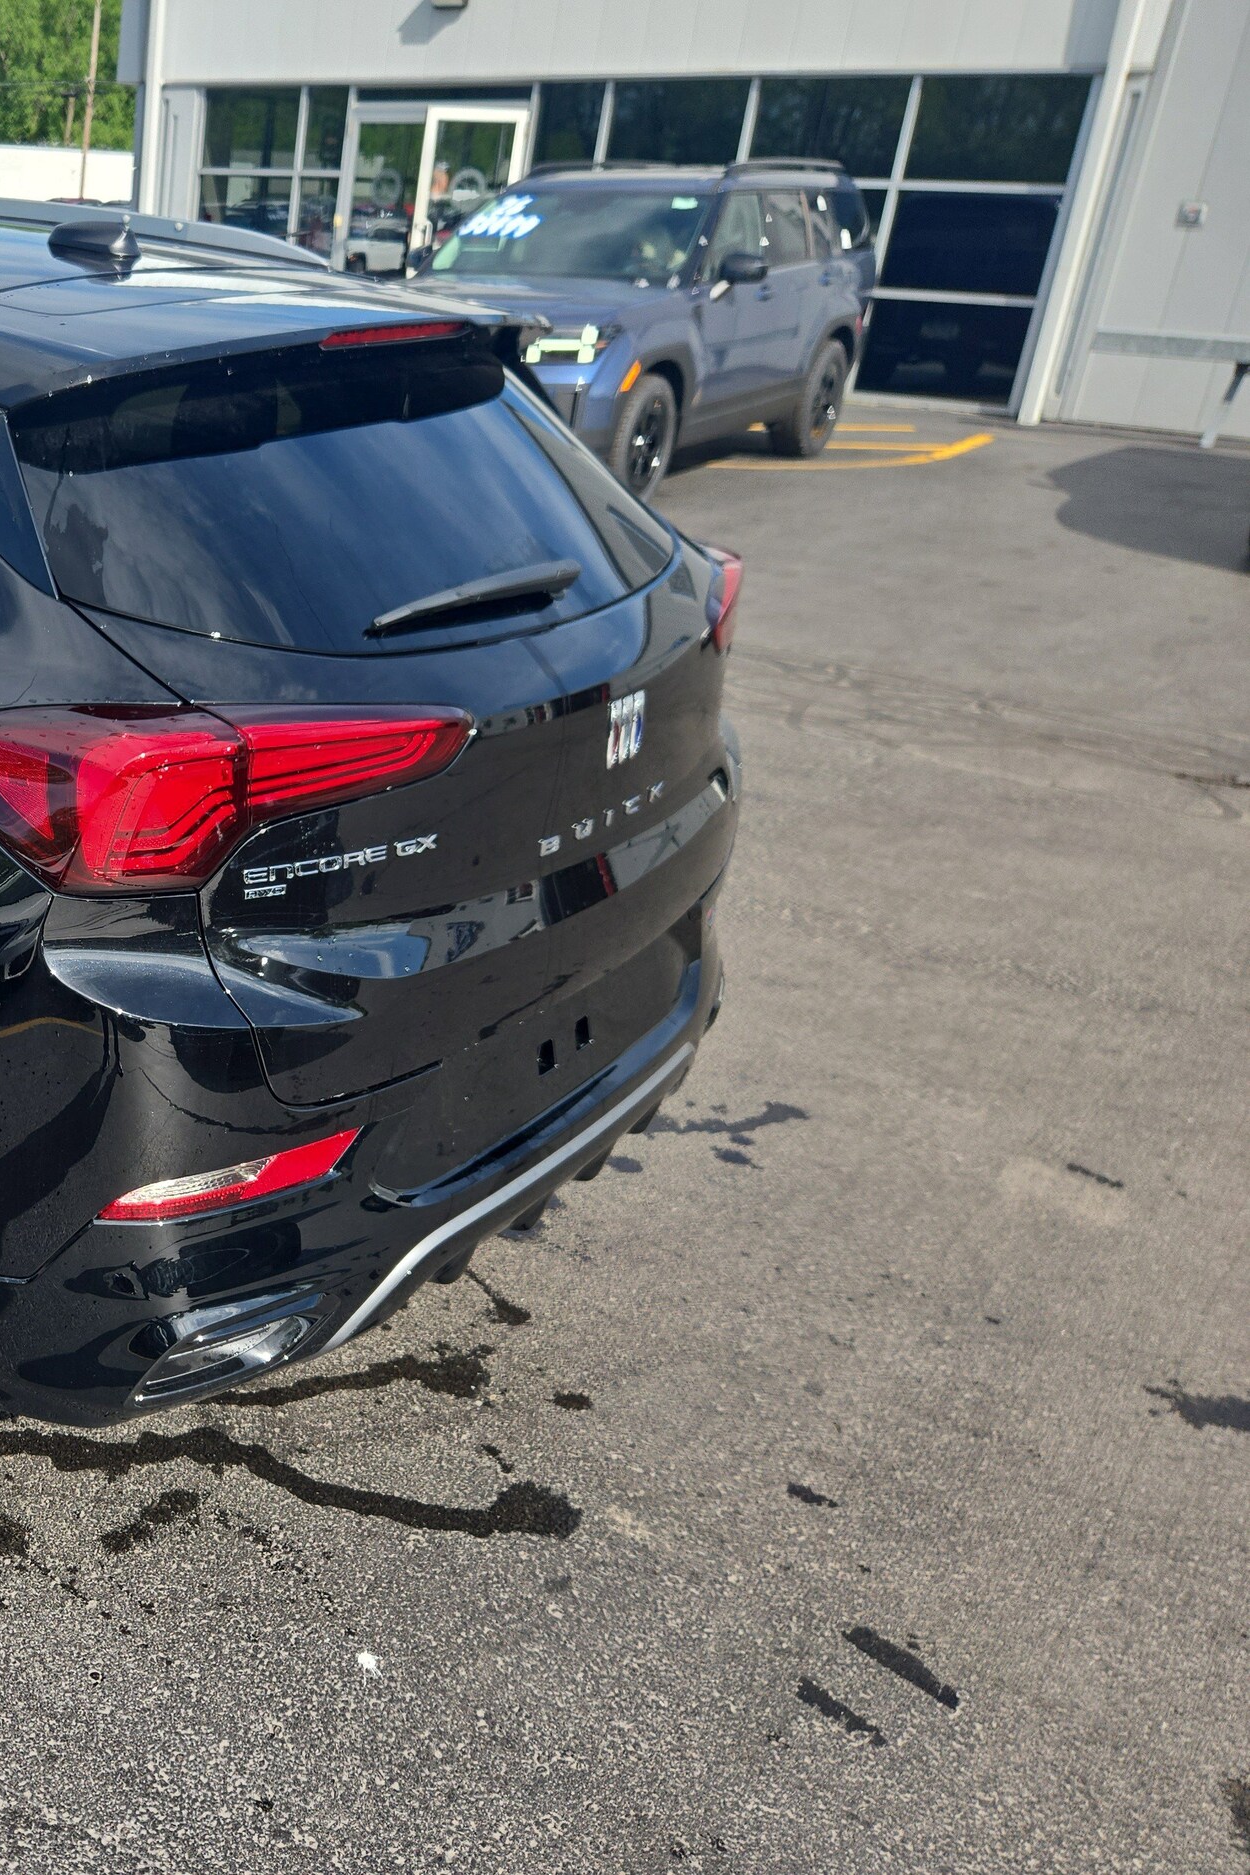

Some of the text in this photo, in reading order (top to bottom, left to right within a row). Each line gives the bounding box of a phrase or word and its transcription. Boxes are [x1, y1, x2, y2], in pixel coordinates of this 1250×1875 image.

[538, 780, 665, 857] BUICK
[243, 833, 438, 885] ENCORE GX
